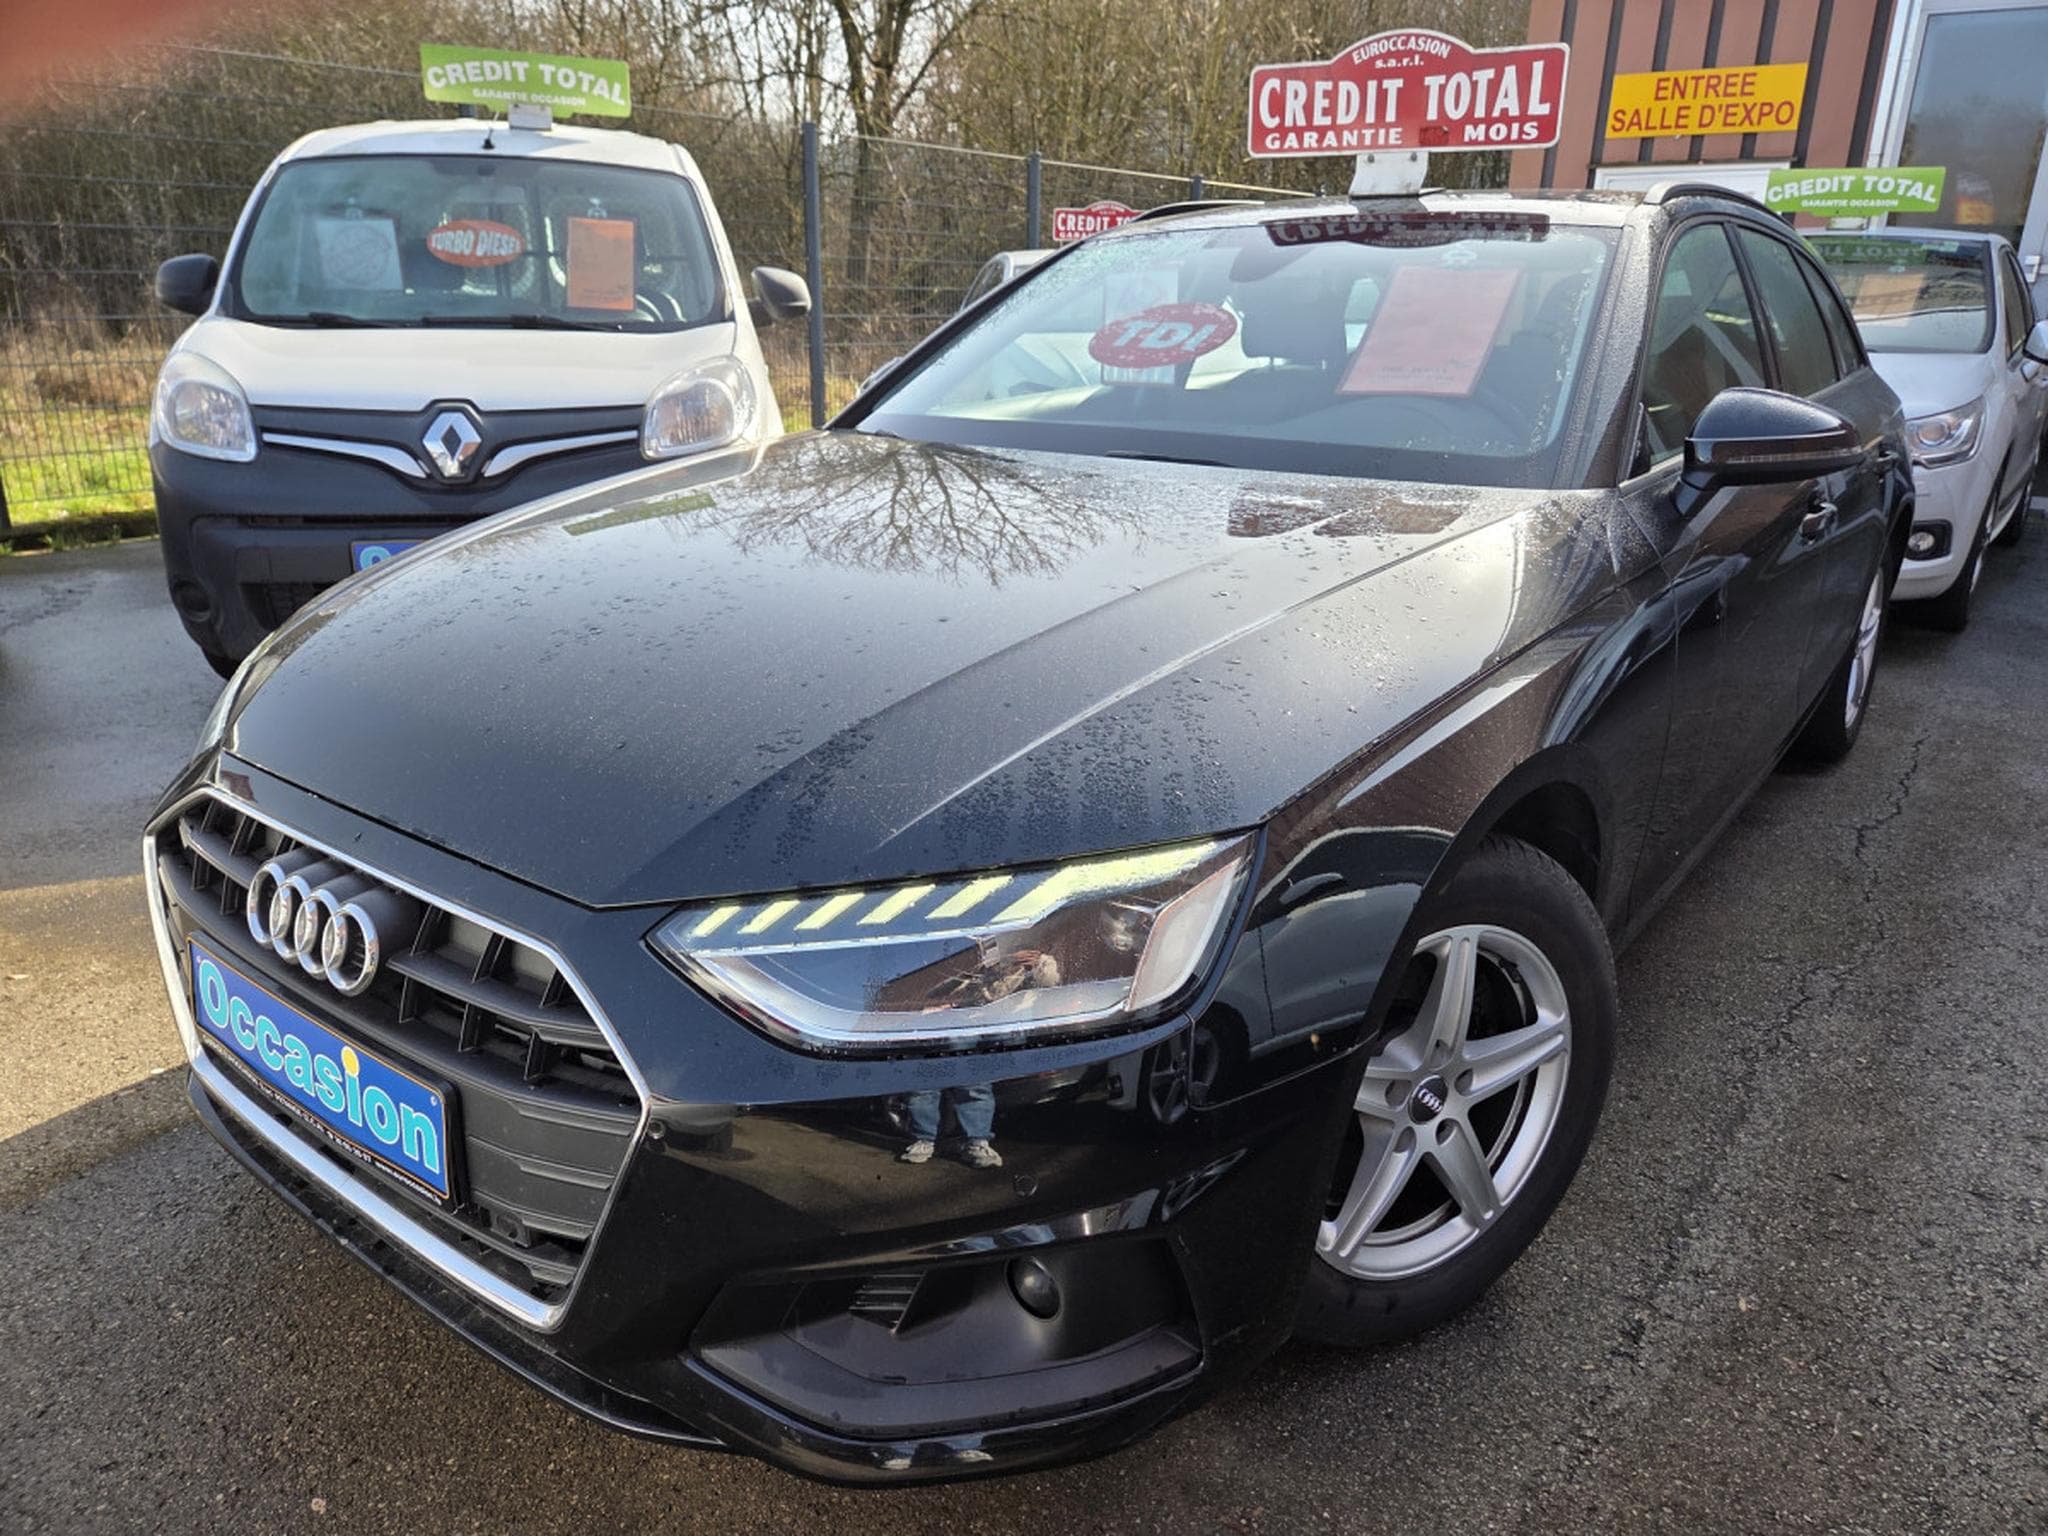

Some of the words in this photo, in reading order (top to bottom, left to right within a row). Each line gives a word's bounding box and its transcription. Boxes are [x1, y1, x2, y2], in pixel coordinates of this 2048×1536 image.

[1352, 34, 1452, 65] EUROCCASION
[1375, 56, 1425, 69] s.a.r.l.
[427, 60, 530, 89] CREDIT
[539, 63, 625, 106] TOTAL
[1258, 77, 1404, 129] CREDIT
[1424, 59, 1551, 121] TOTAL
[1654, 72, 1758, 102] ENTREE
[531, 94, 586, 106] OCCASION
[1611, 105, 1691, 132] SALLE
[1698, 100, 1795, 128] D'EXPO
[1265, 126, 1403, 150] GARANTIE
[1463, 121, 1540, 143] MOIS
[1767, 175, 1856, 202] CREDIT
[1862, 175, 1937, 203] TOTAL
[1849, 199, 1899, 207] OCCASION
[1057, 213, 1110, 231] CREDIT
[431, 229, 475, 255] TURBO
[1113, 320, 1218, 352] TDI
[200, 959, 440, 1175] Occasion
